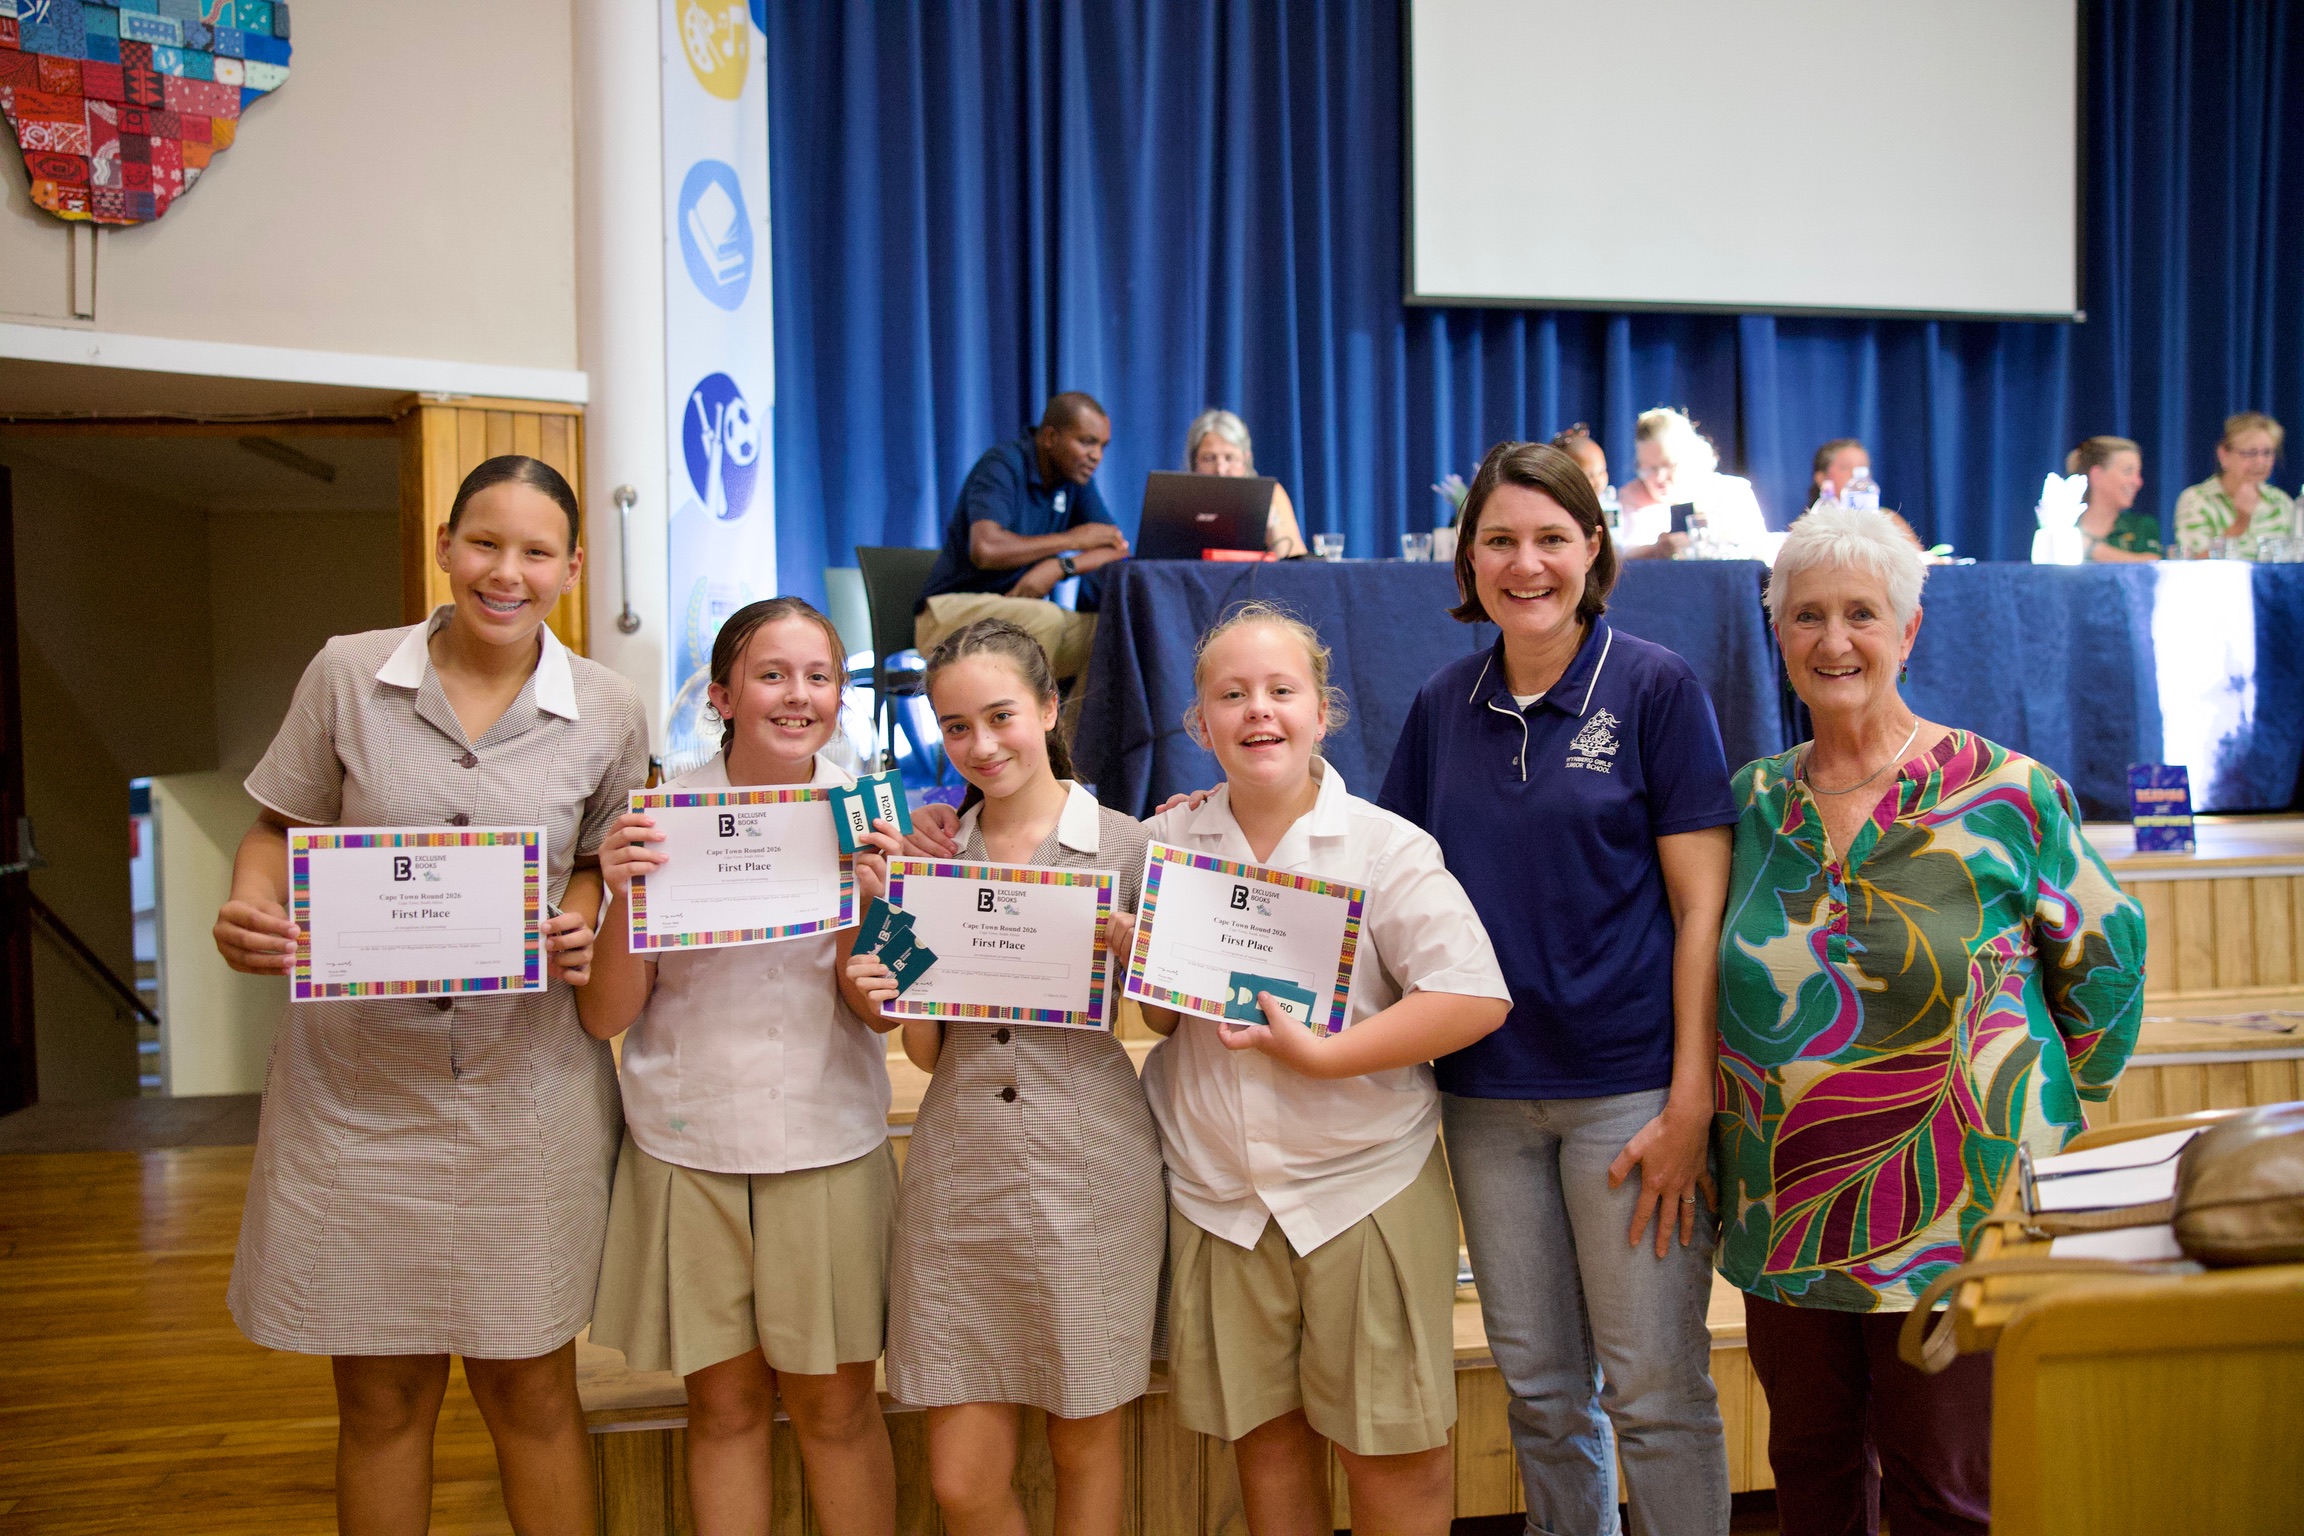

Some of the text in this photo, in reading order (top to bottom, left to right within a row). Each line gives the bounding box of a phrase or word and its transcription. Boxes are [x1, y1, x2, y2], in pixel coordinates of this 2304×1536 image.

[1586, 763, 1611, 774] SCHOOL
[881, 795, 893, 822] R200
[852, 811, 864, 832] R50
[718, 862, 772, 872] First Place
[997, 889, 1027, 897] EXCLUSIVE
[1251, 887, 1281, 899] EXCLUSIVE
[1250, 895, 1271, 904] BOOKS
[392, 908, 451, 919] First Place
[962, 922, 979, 930] Cape
[1022, 926, 1038, 934] 2026
[1213, 916, 1287, 937] Cape Town Round 2026
[972, 937, 1026, 950] First Place
[1220, 933, 1274, 953] First Place
